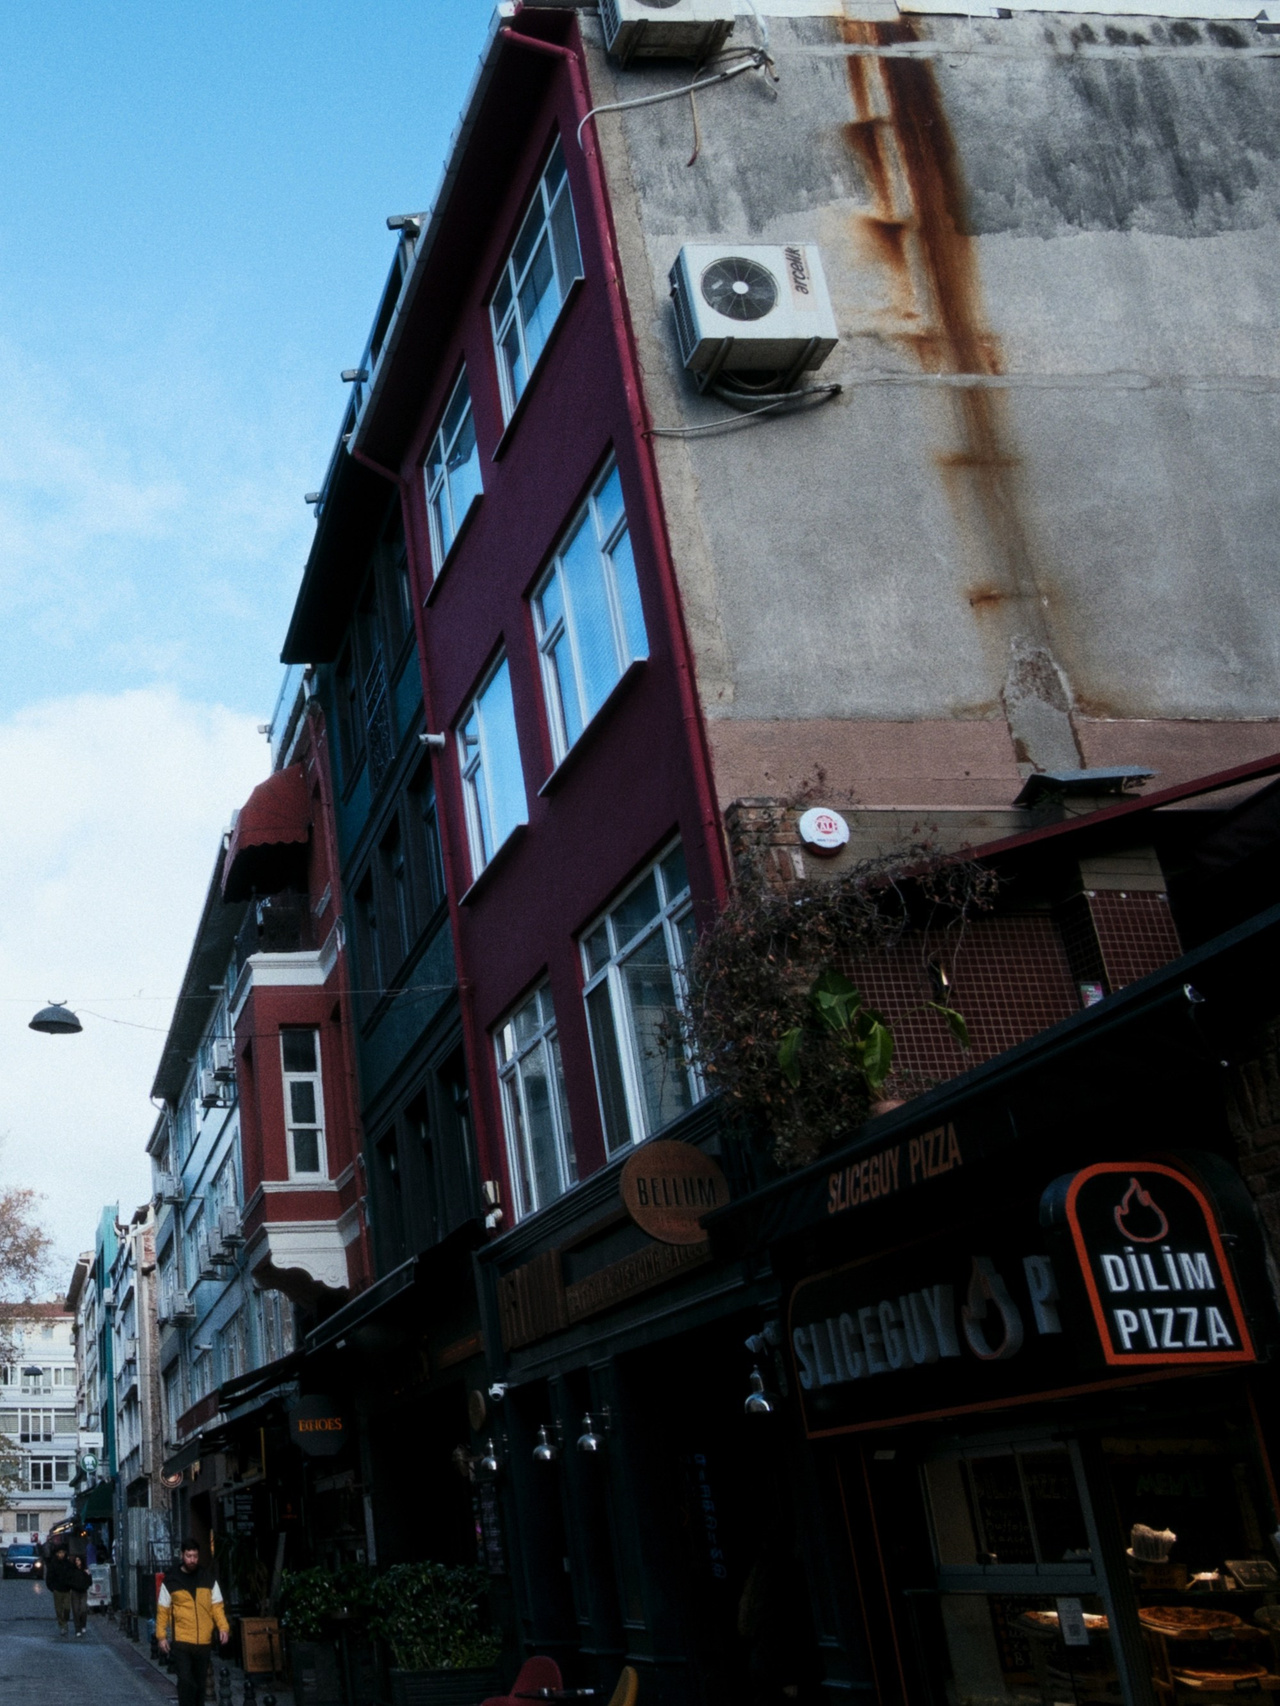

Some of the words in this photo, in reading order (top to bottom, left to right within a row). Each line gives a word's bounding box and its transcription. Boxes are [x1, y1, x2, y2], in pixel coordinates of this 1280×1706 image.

[785, 246, 809, 295] arçelik
[637, 1177, 717, 1206] BELLUM
[827, 1144, 901, 1214] SLICEGUY
[909, 1122, 963, 1182] PIZZA
[1100, 1245, 1216, 1293] DİLİM
[793, 1283, 962, 1390] SLICEGUY
[1113, 1306, 1235, 1350] PIZZA
